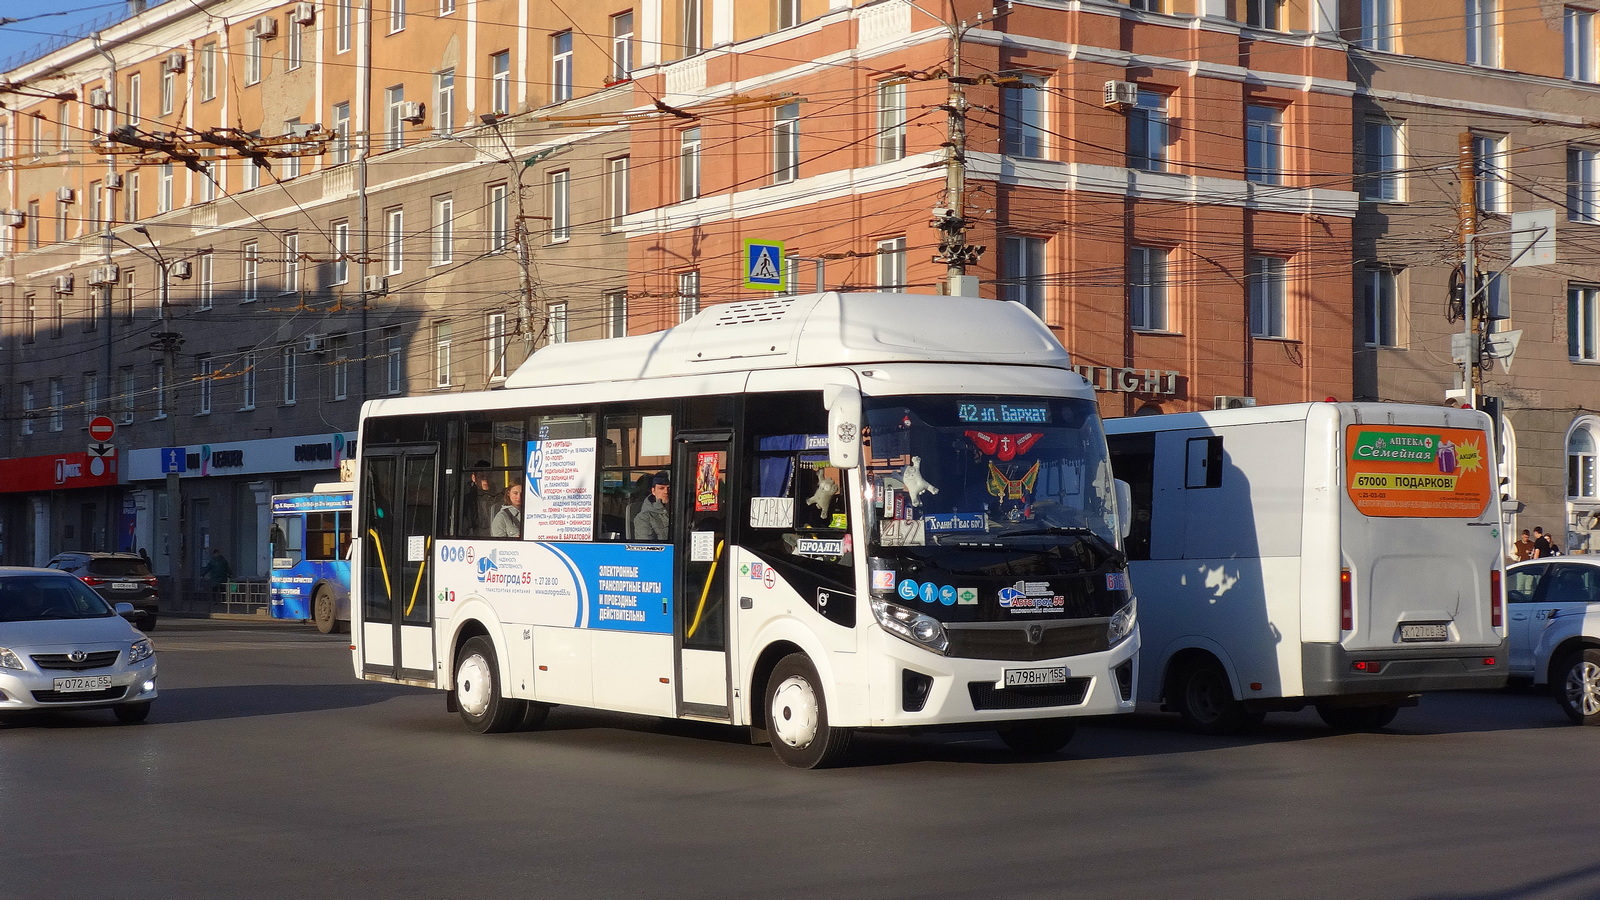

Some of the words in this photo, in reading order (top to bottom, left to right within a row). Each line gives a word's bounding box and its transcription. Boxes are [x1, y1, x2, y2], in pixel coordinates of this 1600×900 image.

[958, 405, 978, 421] 42
[1001, 405, 1046, 422] Бархат
[1390, 438, 1424, 446] АПТЕКА
[1358, 445, 1431, 460] Семейная
[528, 450, 542, 478] 42
[1358, 476, 1387, 486] 67000
[1396, 477, 1453, 488] ПОДАРКОВ!
[881, 520, 922, 546] 42
[800, 541, 840, 553] БРОДЯГА
[599, 566, 638, 577] ЭЛЕКТРОННЫЕ
[752, 564, 762, 578] 42
[486, 571, 520, 587] Автоград
[521, 572, 531, 584] 55
[599, 580, 641, 592] ТРАНСПОРТНЫЕ
[642, 582, 661, 593] КАРТЫ
[599, 594, 603, 604] И
[604, 594, 637, 608] ПРОЕЗДНЫЕ
[1012, 597, 1053, 609] Автоград
[1053, 596, 1064, 606] 55
[599, 607, 645, 622] ДЕЙСТВИТЕЛЬНЫ
[58, 678, 96, 689] У072АС
[1009, 671, 1048, 684] А798НУ
[1050, 669, 1064, 678] 155
